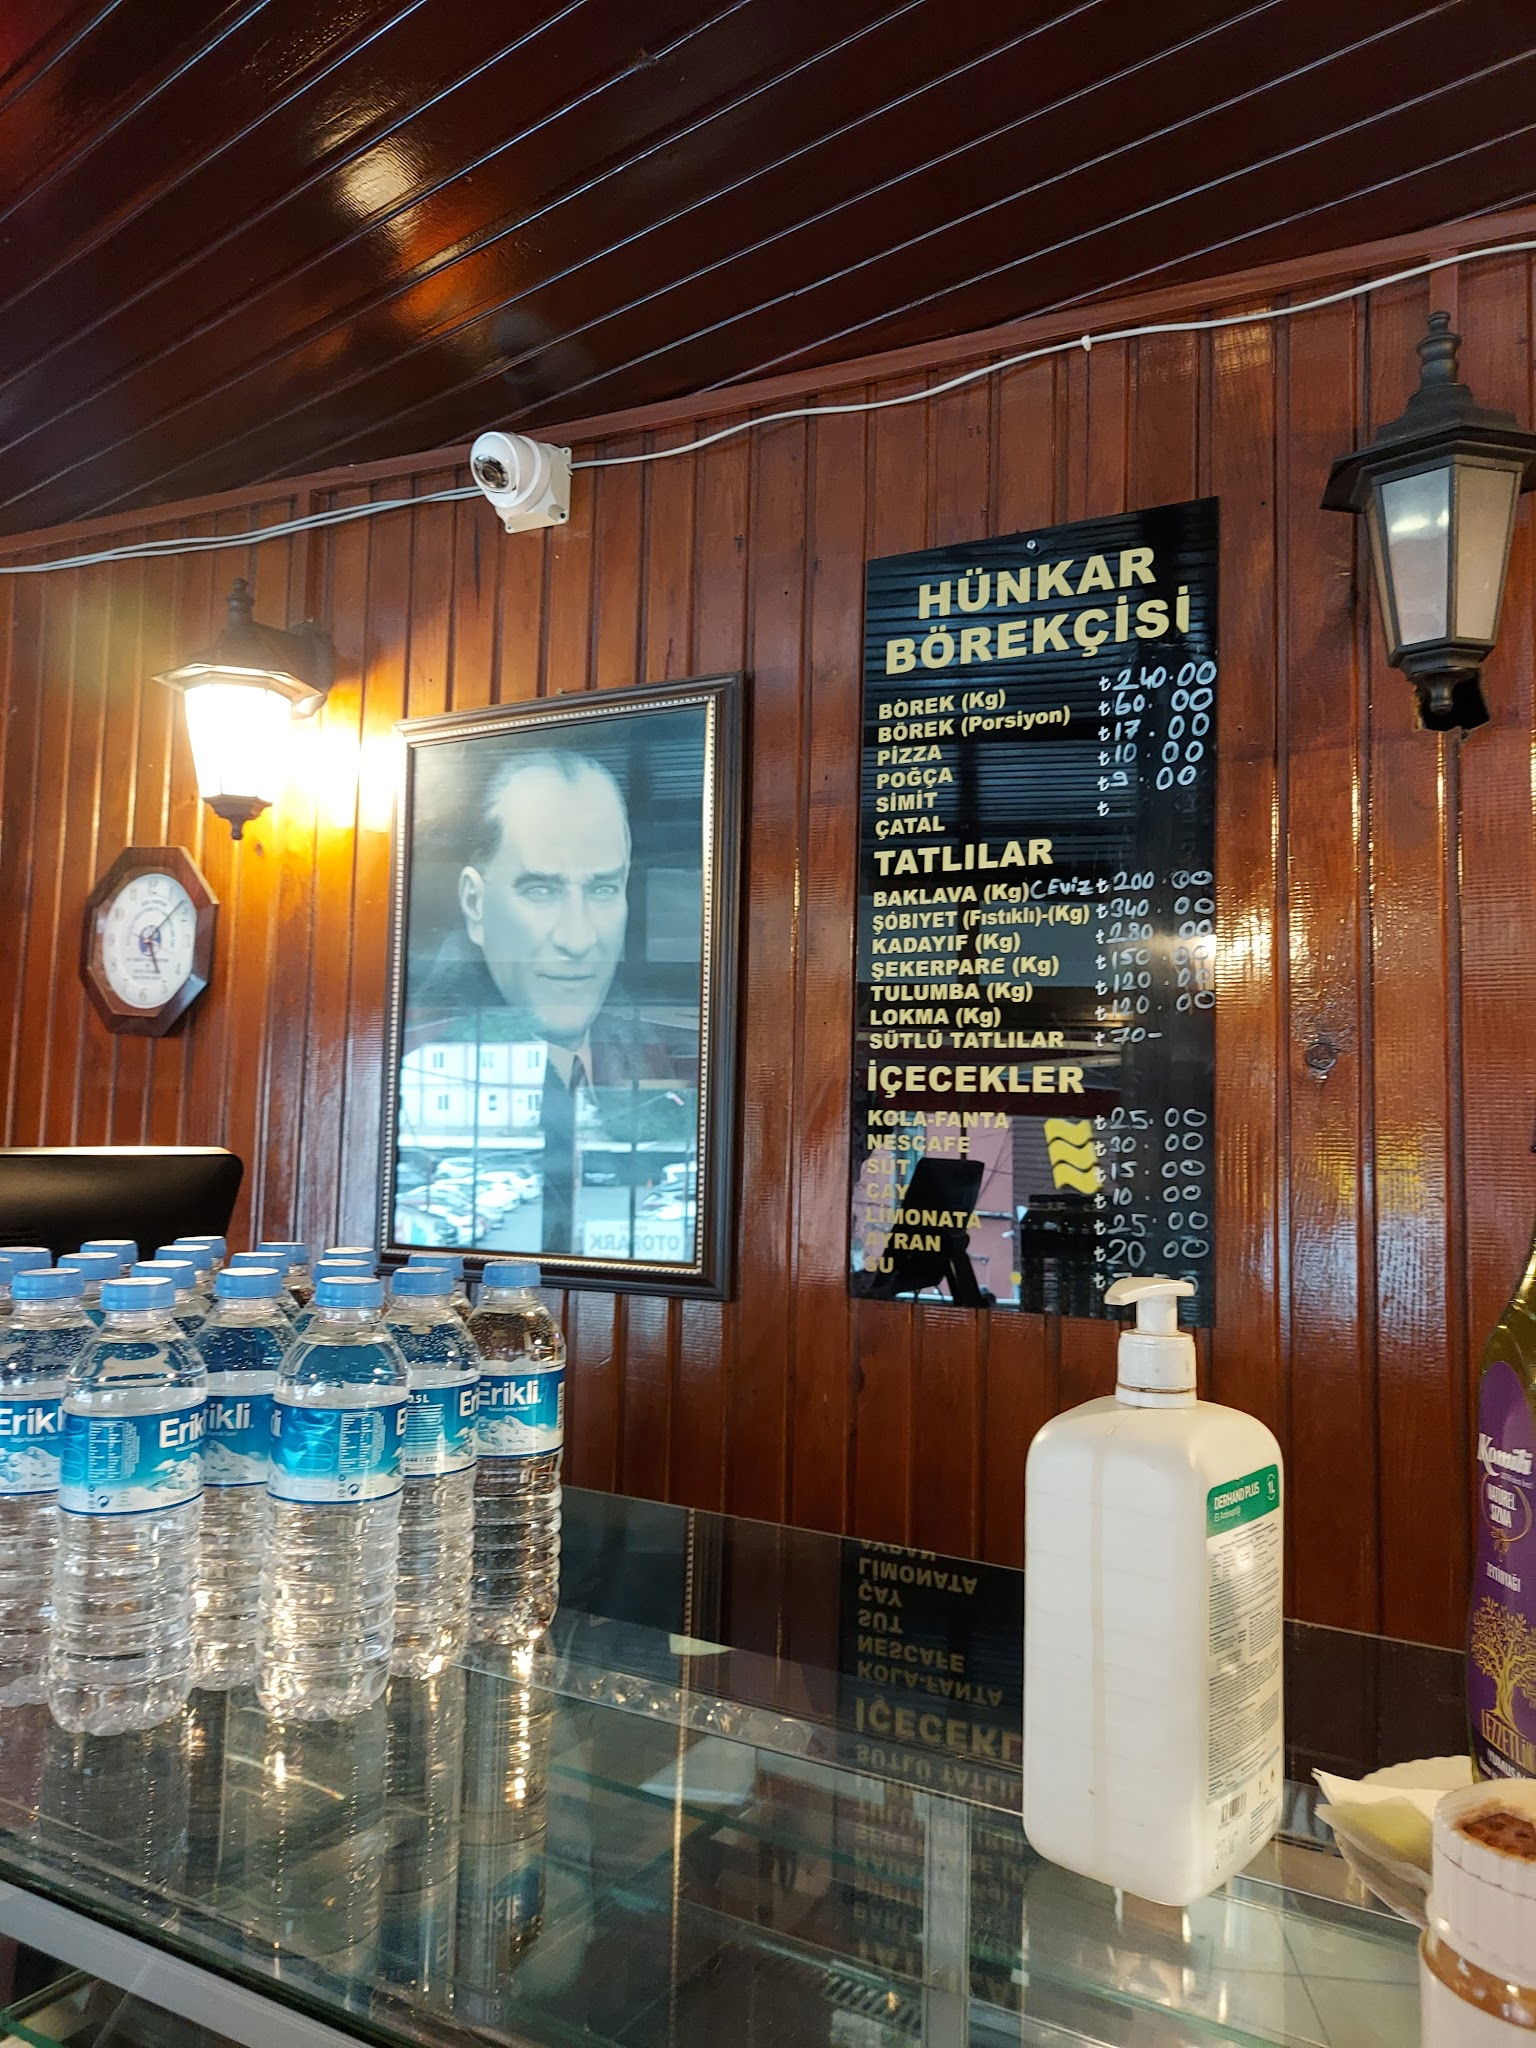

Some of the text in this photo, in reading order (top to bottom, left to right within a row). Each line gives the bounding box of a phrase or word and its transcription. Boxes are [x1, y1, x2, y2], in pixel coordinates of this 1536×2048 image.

[918, 547, 1156, 620] HÜNKAR
[886, 585, 1190, 675] BÖREKÇİSİ
[961, 688, 1006, 713] (Kg)
[878, 718, 955, 743] BÖREK
[961, 705, 1071, 737] (Porsiyon)
[877, 744, 942, 766] PİZZA
[876, 767, 953, 789] POĞÇA
[875, 789, 938, 813] SİMİT
[875, 815, 946, 840] ÇATAL
[874, 838, 1054, 876] TATLILAR
[873, 885, 977, 908] BAKLAVA
[983, 882, 1030, 904] (Kg)
[871, 934, 969, 955] KADAYIF
[974, 932, 1021, 954] (Kg)
[871, 957, 1006, 982] ŞEKERPARE
[1012, 956, 1060, 977] (Kg)
[870, 983, 980, 1002] TULUMBA
[986, 981, 1033, 1003] (Kg)
[869, 1007, 949, 1026] LOKMA
[955, 1006, 1001, 1028] (Kg)
[869, 1029, 943, 1049] SÜTLÜ
[950, 1031, 1065, 1049] TATLILAR
[867, 1059, 1085, 1098] İÇECEKLER
[867, 1110, 1010, 1129] KOLA-FANTA
[867, 1133, 972, 1153] NESCAFE
[865, 1203, 982, 1229] LİMONATA
